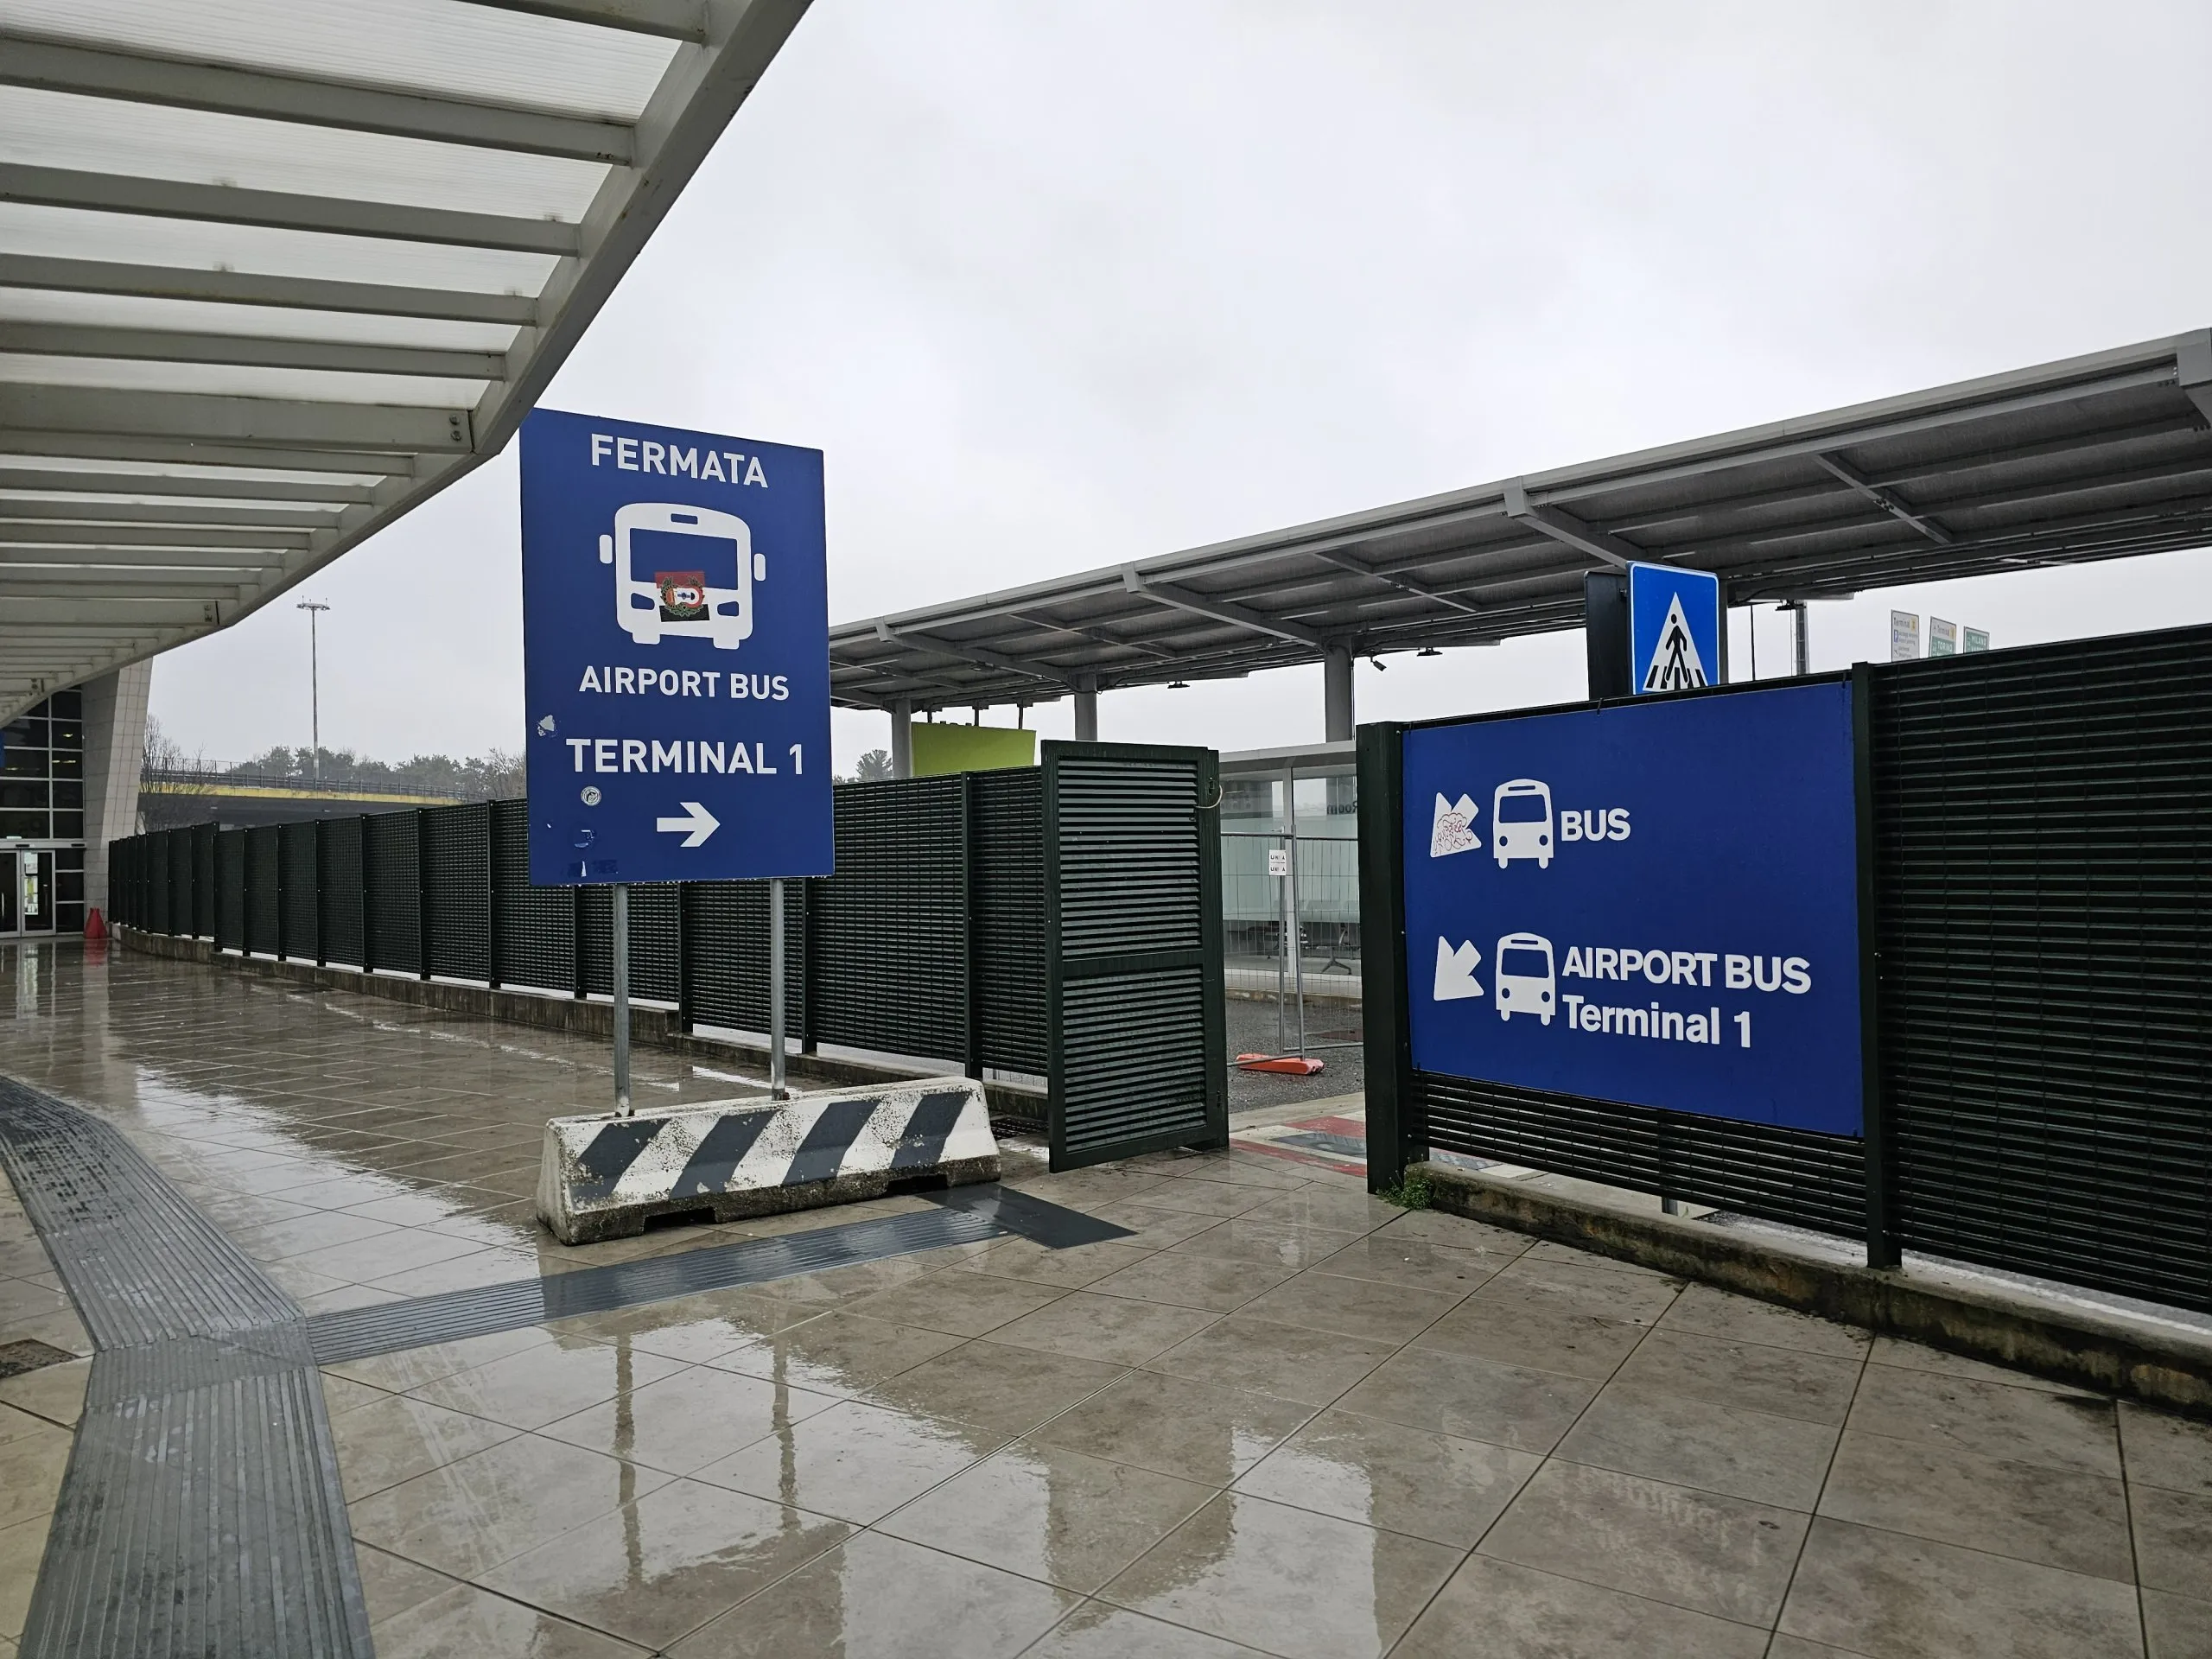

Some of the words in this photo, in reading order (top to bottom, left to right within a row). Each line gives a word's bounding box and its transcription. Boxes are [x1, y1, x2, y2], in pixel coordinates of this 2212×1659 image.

[592, 434, 768, 488] FERMATA
[579, 666, 721, 696] AIRPORT
[730, 672, 790, 701] BUS
[566, 739, 777, 774] TERMINAL
[789, 744, 803, 774] 1
[1560, 808, 1630, 842] BUS
[1561, 947, 1717, 987] AIRPORT
[1726, 955, 1811, 995] BUS
[1562, 995, 1719, 1045] Terminal
[1733, 1012, 1751, 1048] 1
